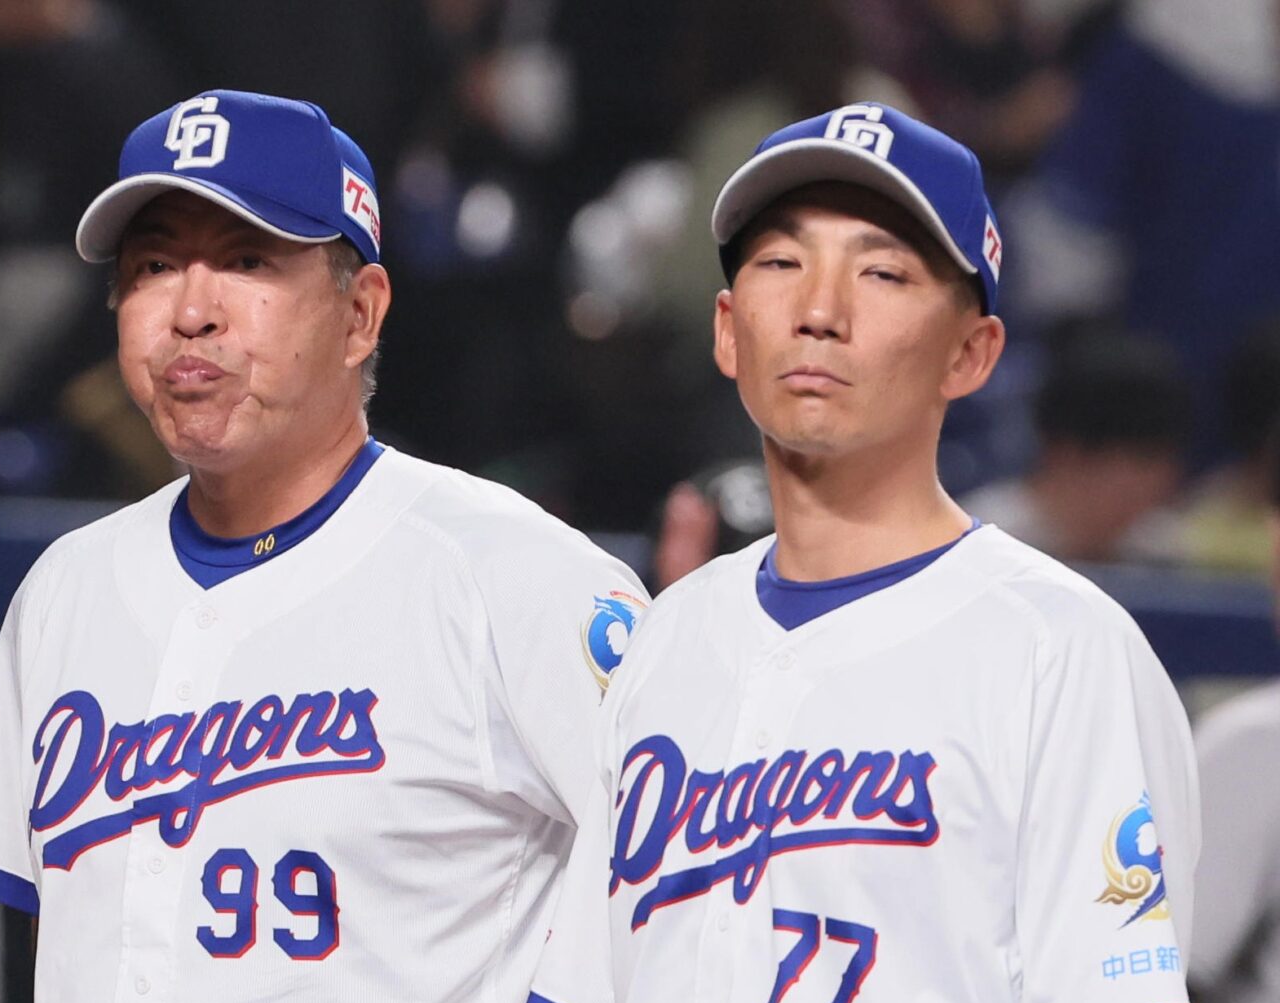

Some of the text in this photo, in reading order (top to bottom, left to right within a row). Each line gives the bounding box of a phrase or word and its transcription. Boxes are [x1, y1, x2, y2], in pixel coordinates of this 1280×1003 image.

[29, 688, 386, 870] Dragons
[609, 735, 940, 934] Dragons
[196, 848, 341, 962] 99
